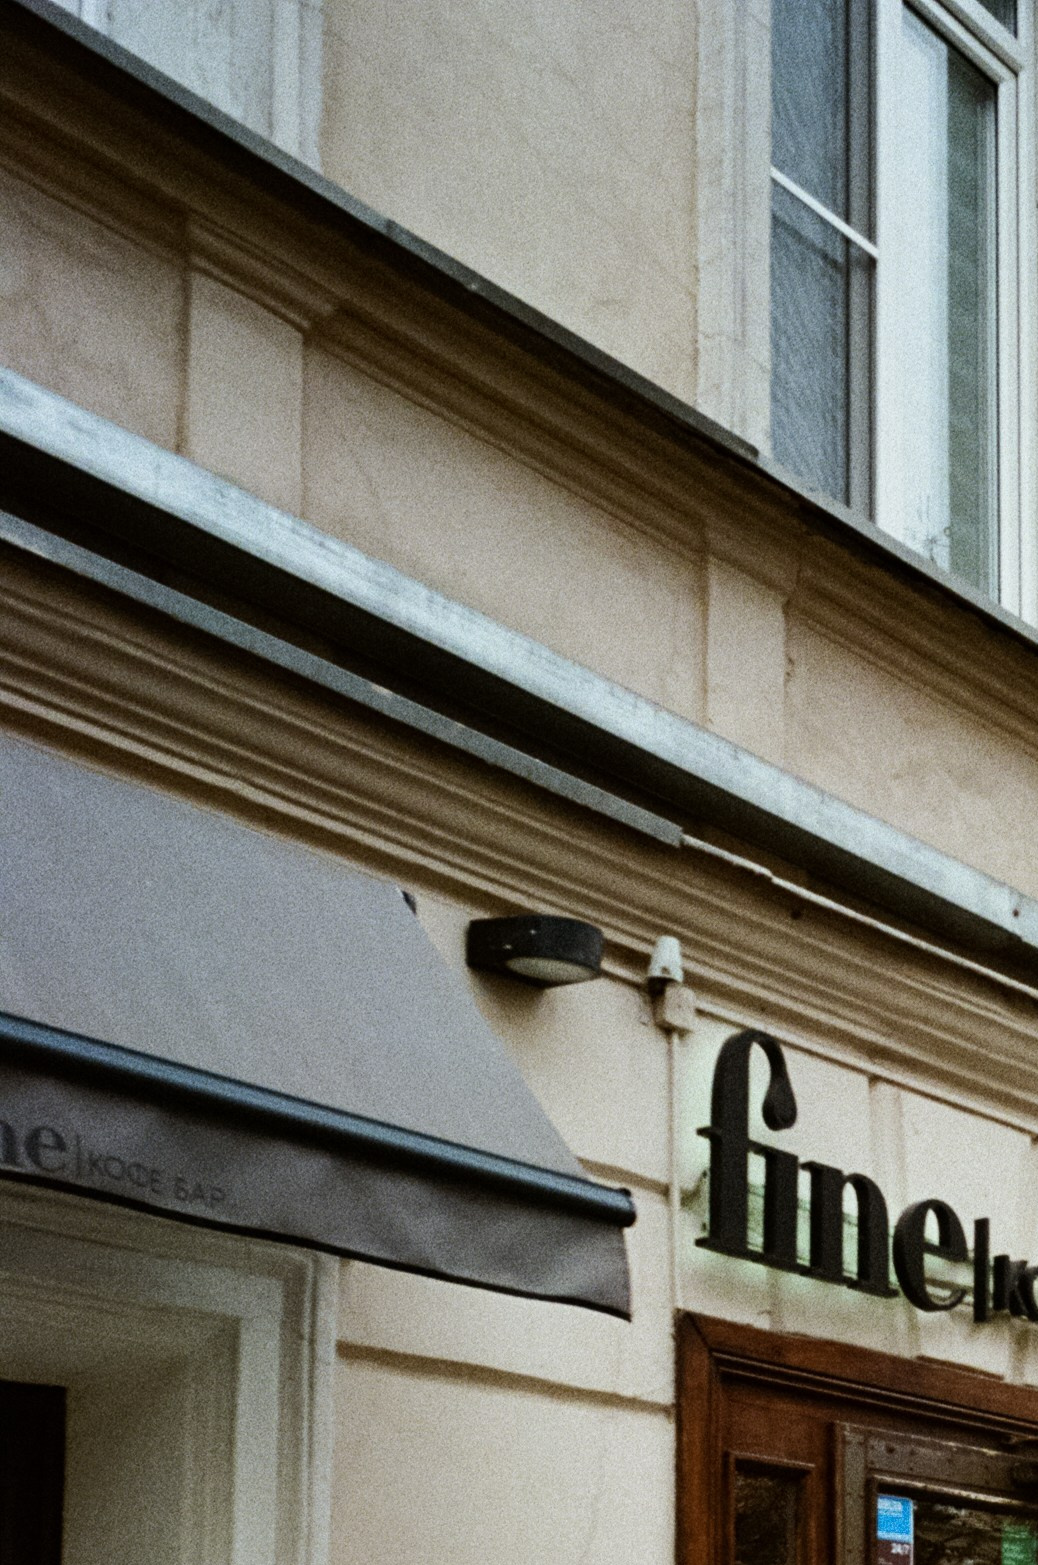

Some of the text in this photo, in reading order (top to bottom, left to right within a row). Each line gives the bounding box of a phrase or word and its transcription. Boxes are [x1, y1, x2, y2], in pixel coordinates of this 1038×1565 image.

[89, 1152, 161, 1194] КОФЕ
[174, 1177, 227, 1208] БАР
[695, 1030, 967, 1312] fine
